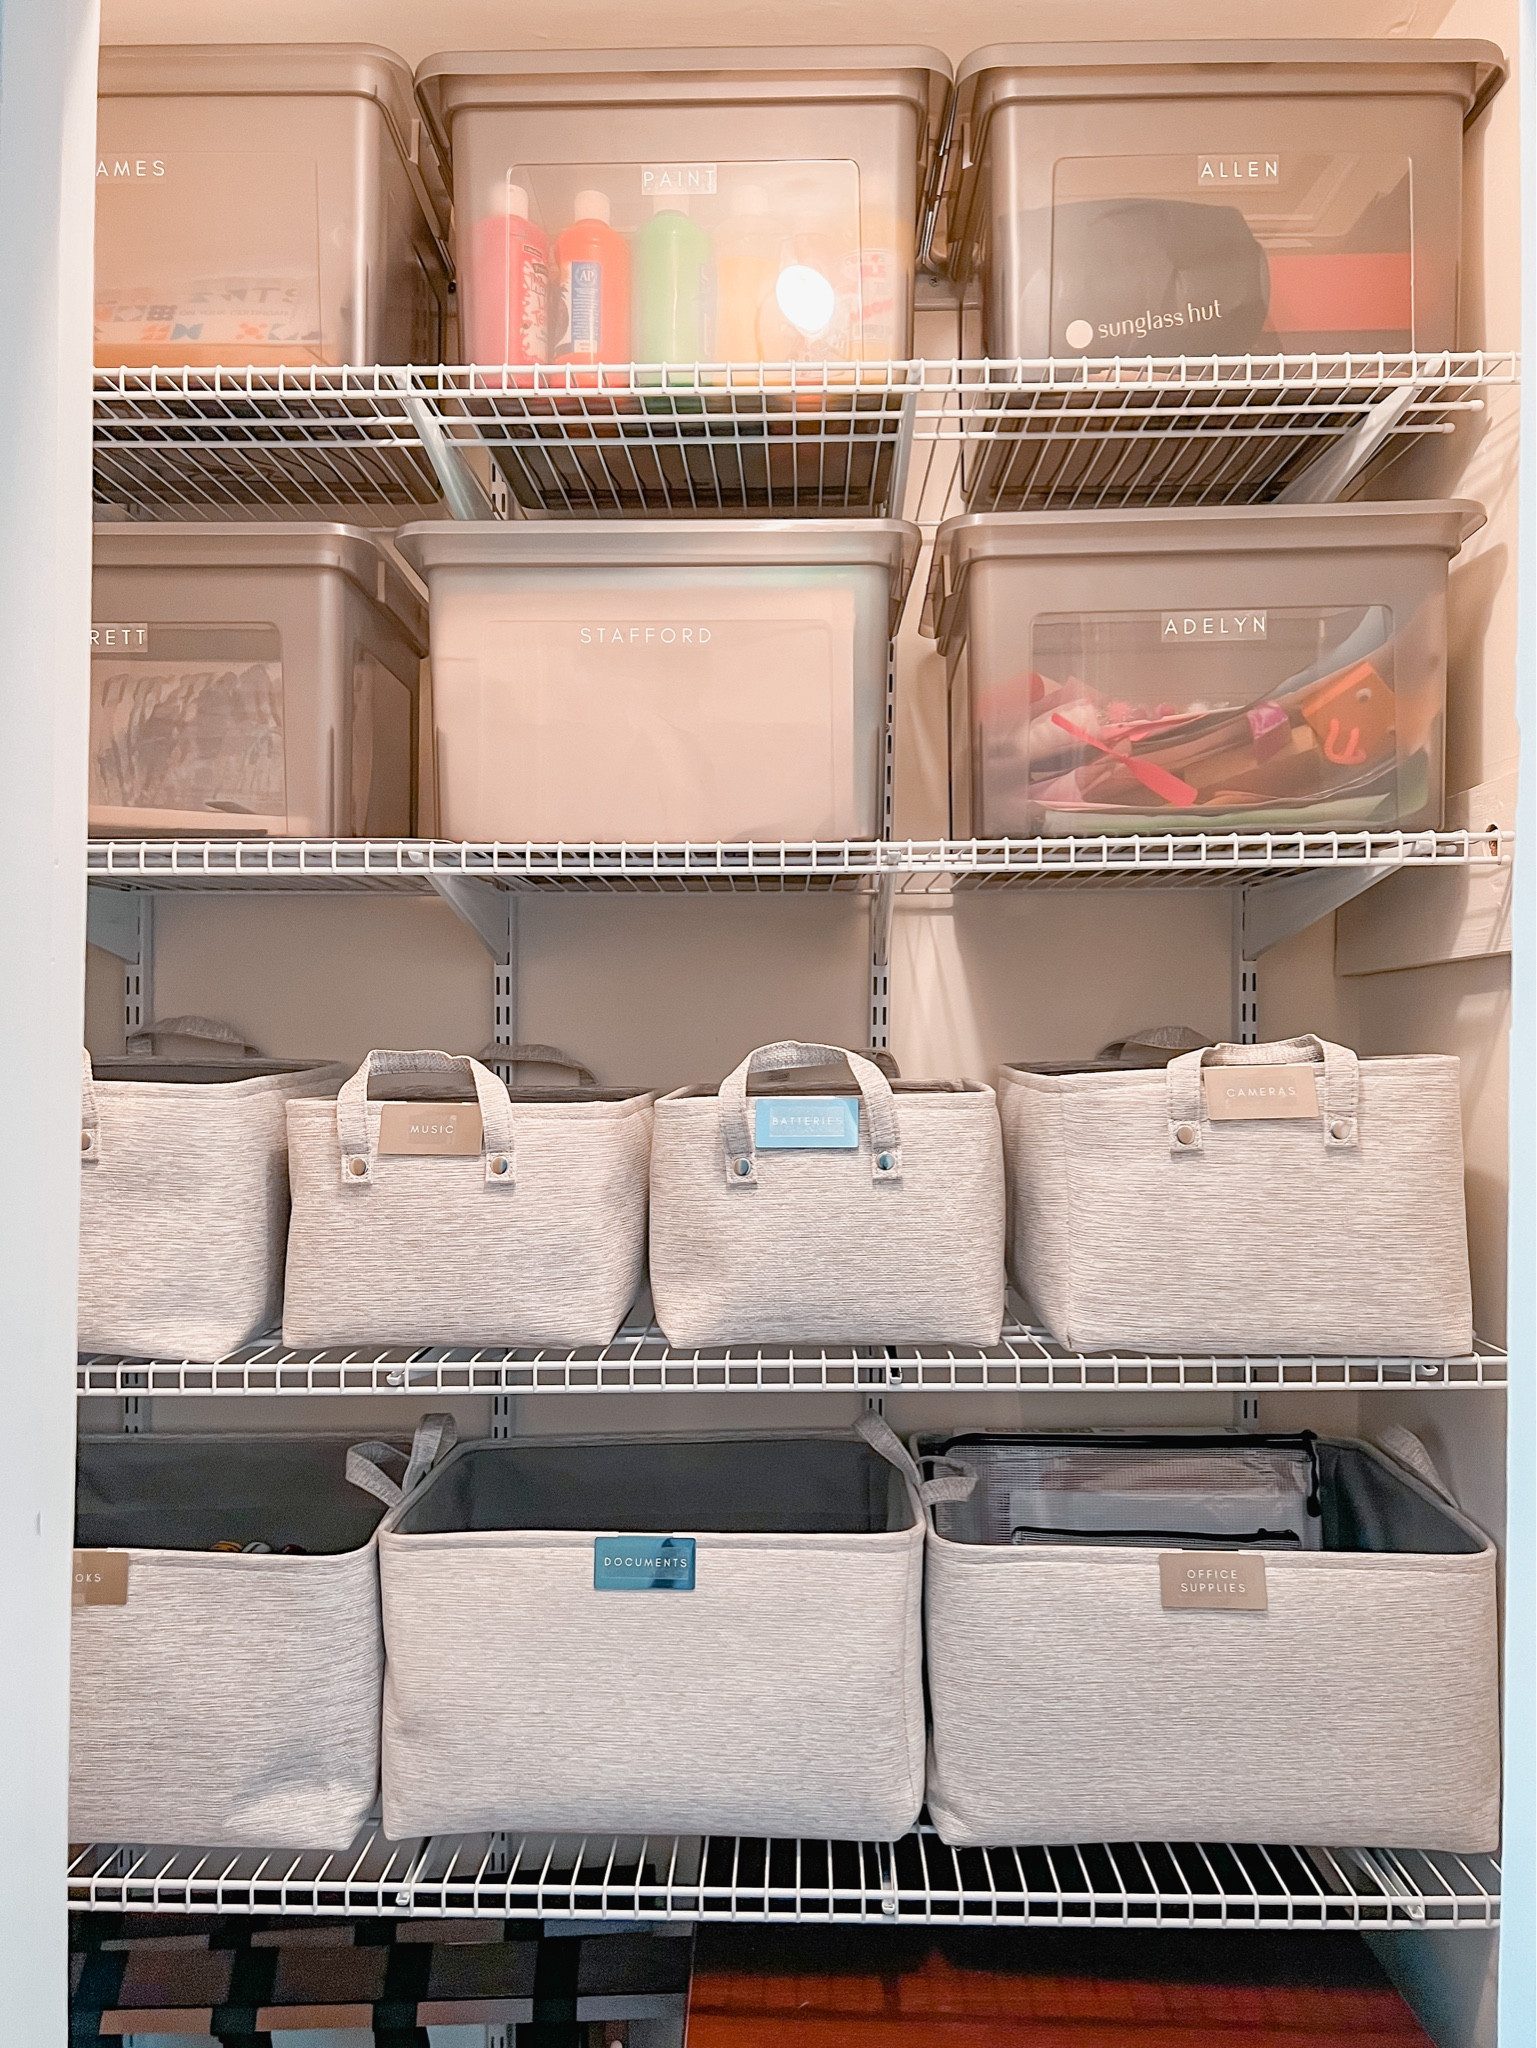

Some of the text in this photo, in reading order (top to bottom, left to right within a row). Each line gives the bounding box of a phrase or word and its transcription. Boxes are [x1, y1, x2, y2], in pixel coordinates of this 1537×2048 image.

[1200, 160, 1278, 178] ALLEN
[643, 169, 715, 188] PAINT
[579, 269, 594, 282] AP
[1097, 299, 1223, 339] sunglass hut
[1163, 616, 1266, 635] ADELYN
[579, 626, 713, 644] STAFFORD
[1225, 1085, 1297, 1098] CAMERAS
[771, 1115, 845, 1127] BATTERIES
[409, 1124, 455, 1135] MUSIC
[603, 1556, 688, 1568] DOCUMENTS
[1186, 1569, 1239, 1579] OFFICE
[1180, 1582, 1246, 1593] SUPPLIES
